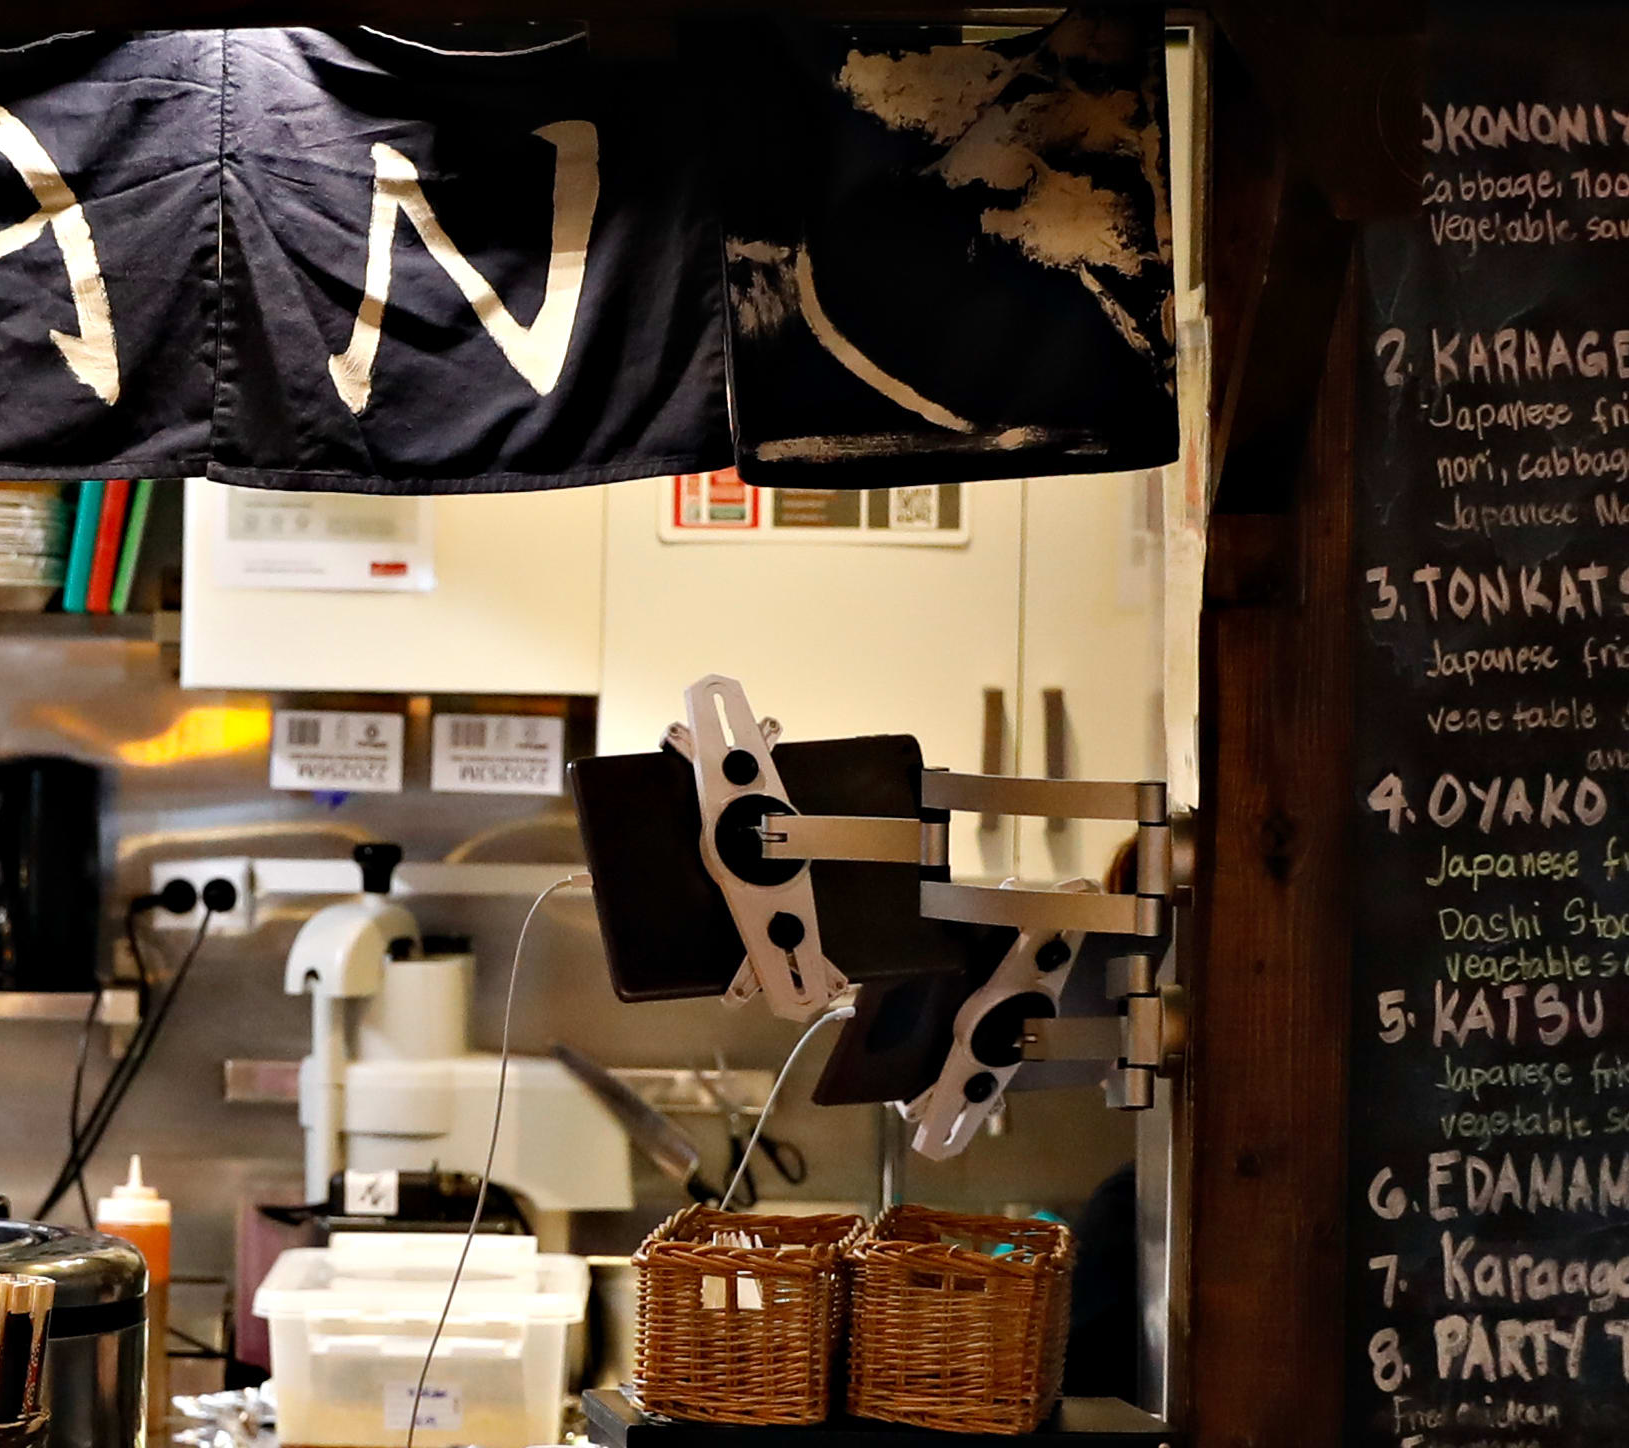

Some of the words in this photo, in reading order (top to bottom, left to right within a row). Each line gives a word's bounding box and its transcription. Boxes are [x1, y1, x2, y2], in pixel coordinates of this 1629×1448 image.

[1426, 772, 1609, 834] OYAKO
[1437, 899, 1543, 944] Dashi
[1431, 979, 1606, 1049] KATSU
[1432, 1313, 1589, 1383] PARTY
